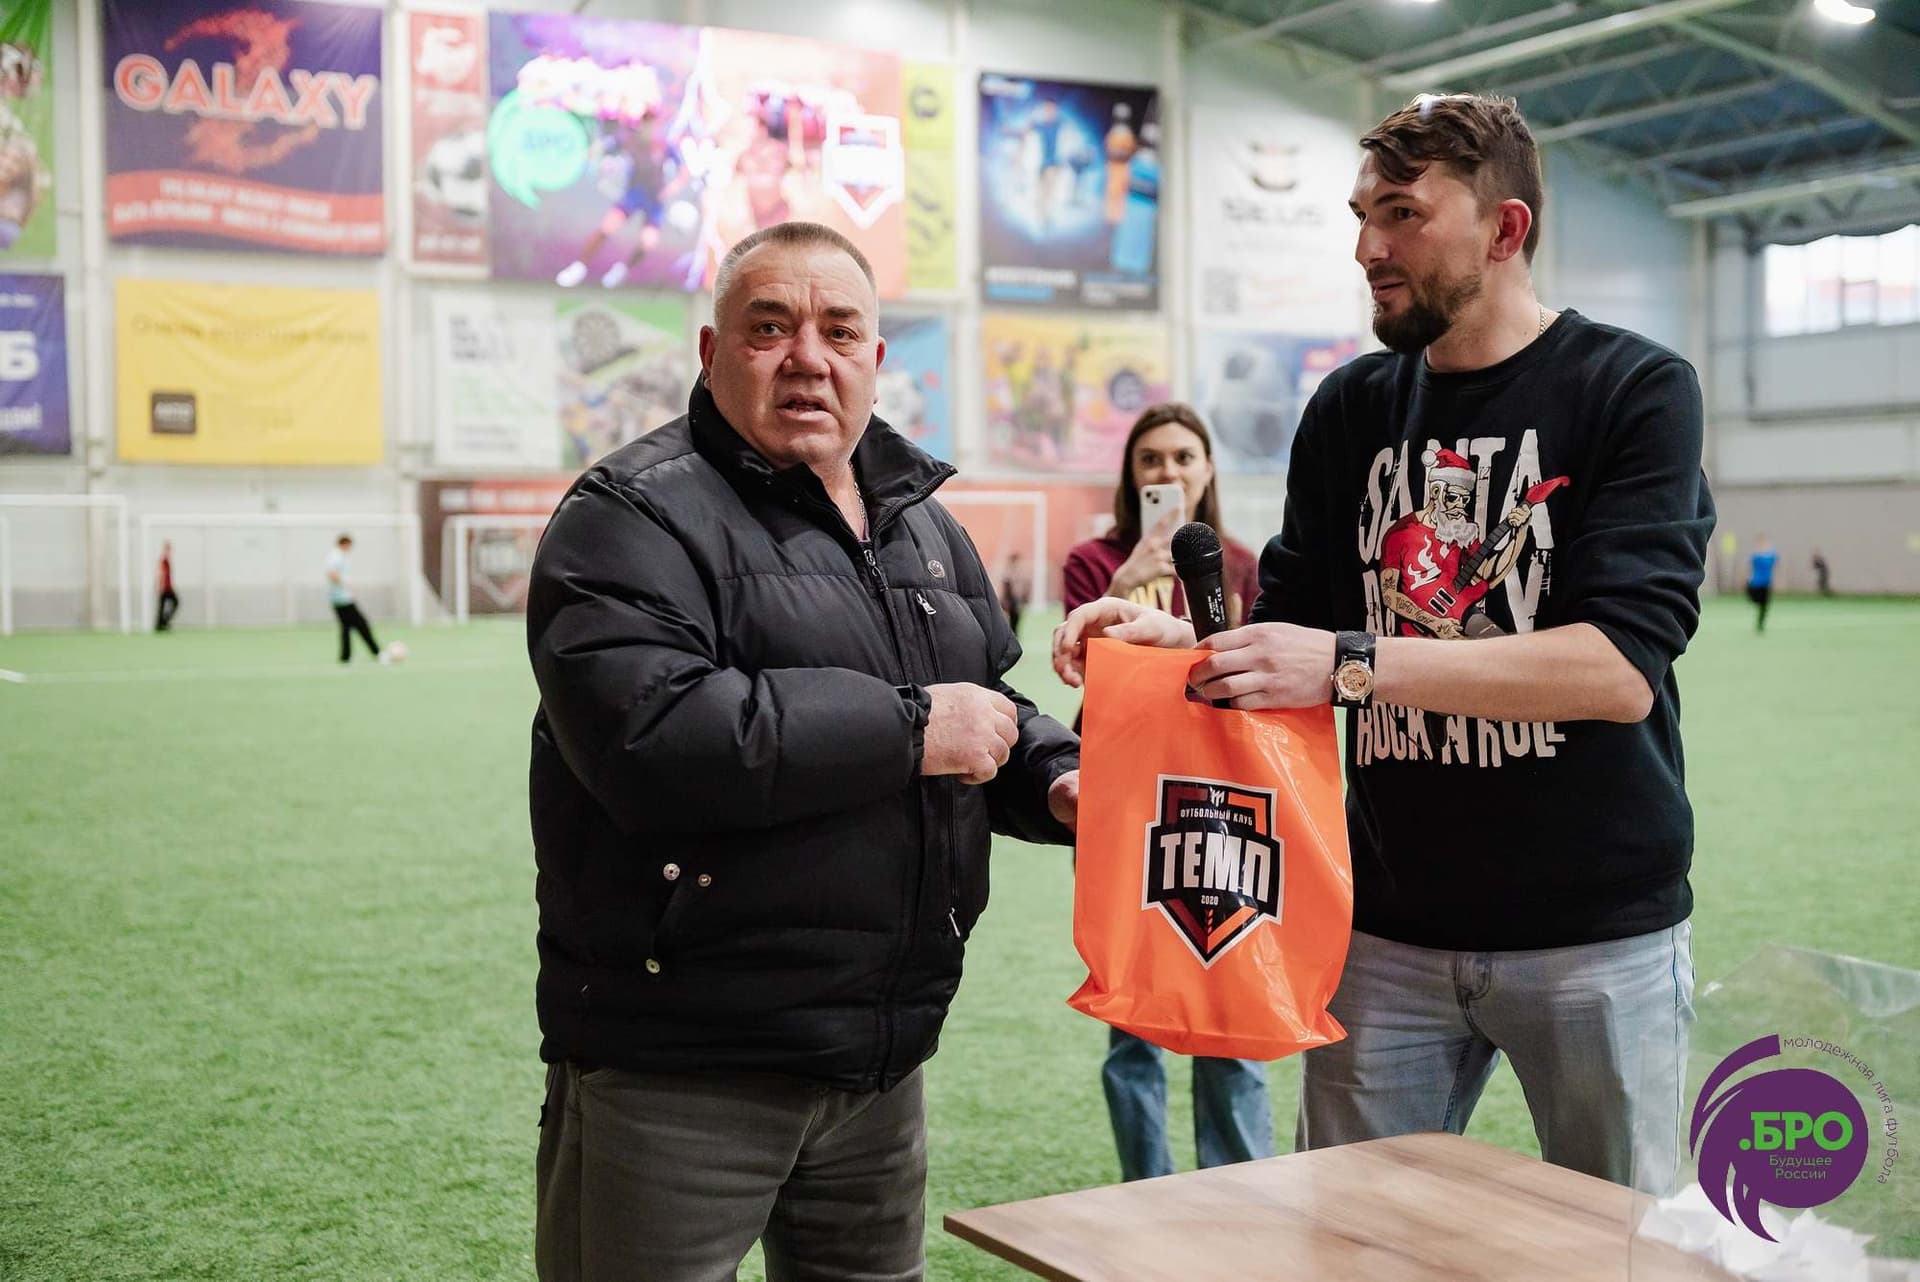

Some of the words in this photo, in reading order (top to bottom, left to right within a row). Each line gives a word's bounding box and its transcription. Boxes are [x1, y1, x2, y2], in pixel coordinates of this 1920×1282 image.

[114, 54, 378, 130] GALAXY
[1356, 700, 1434, 767] ROCK
[1180, 808, 1231, 821] ФУТБОЛЬНЫЙ
[1232, 812, 1253, 826] КЛУБ
[1160, 831, 1271, 903] ТЕМП
[1201, 895, 1219, 905] 2020
